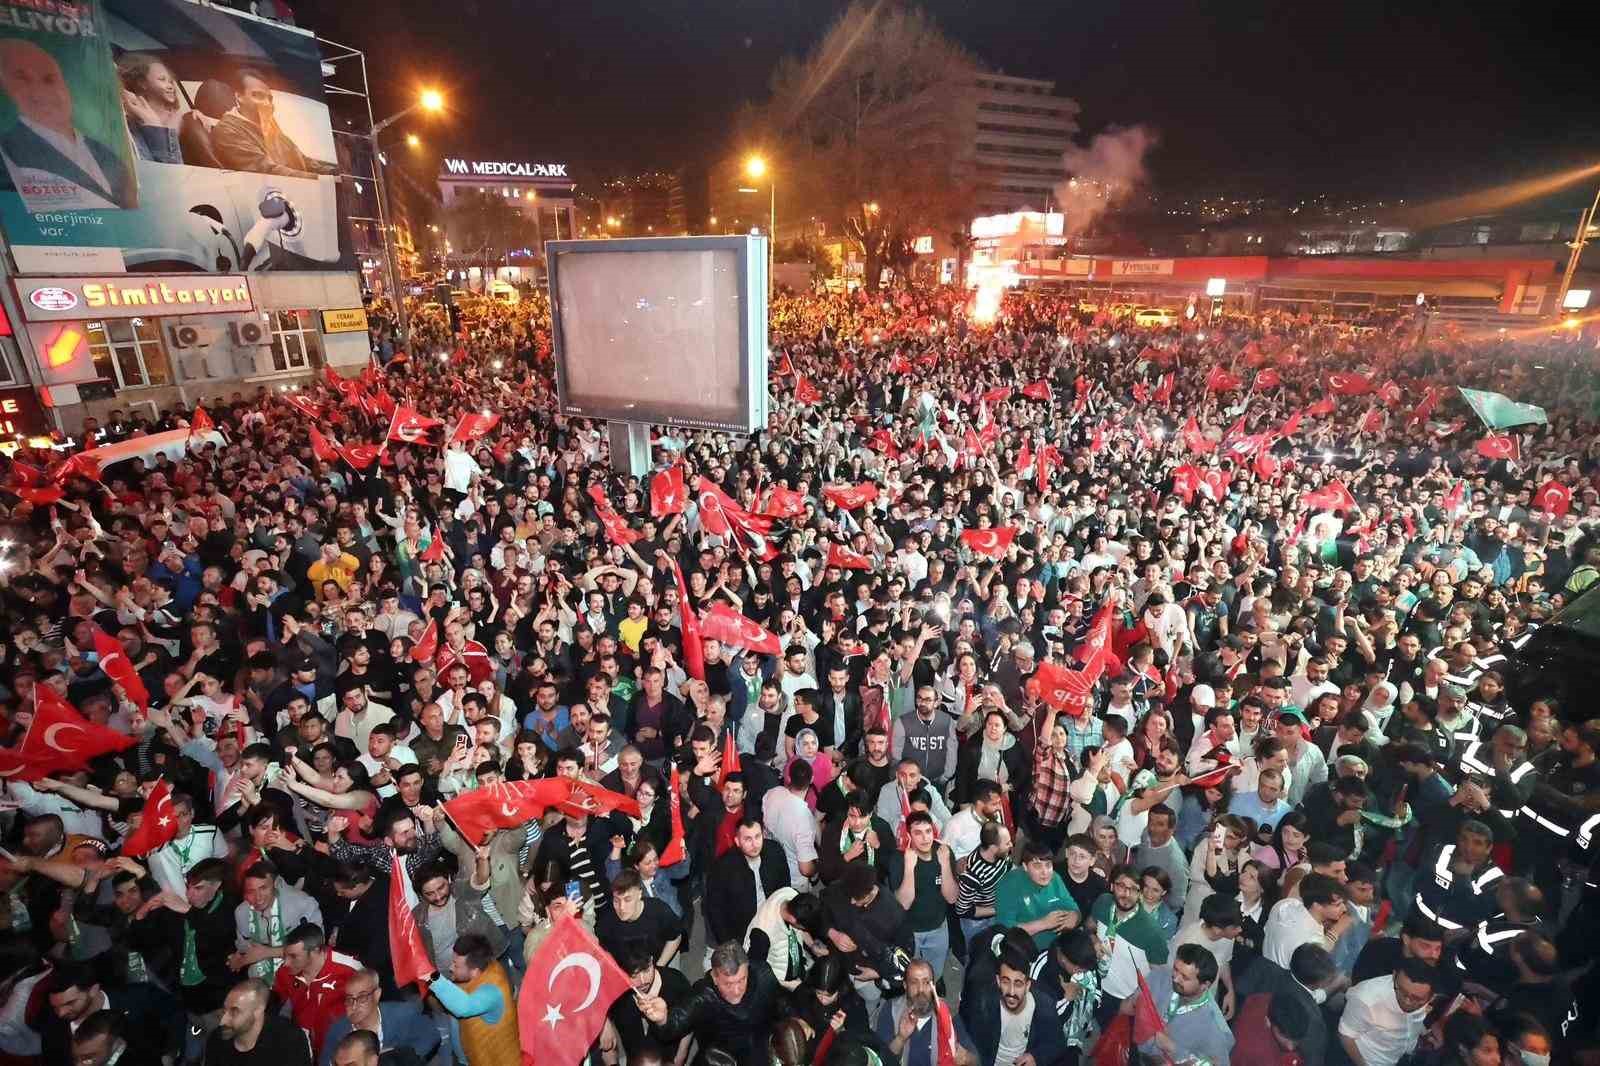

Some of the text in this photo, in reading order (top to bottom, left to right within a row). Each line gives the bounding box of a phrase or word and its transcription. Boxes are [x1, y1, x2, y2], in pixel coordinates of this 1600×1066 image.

[445, 158, 469, 174] VM
[34, 212, 104, 227] enerjimiz
[39, 225, 70, 237] var.
[82, 282, 248, 307] Simitasyon
[909, 735, 945, 751] WEST
